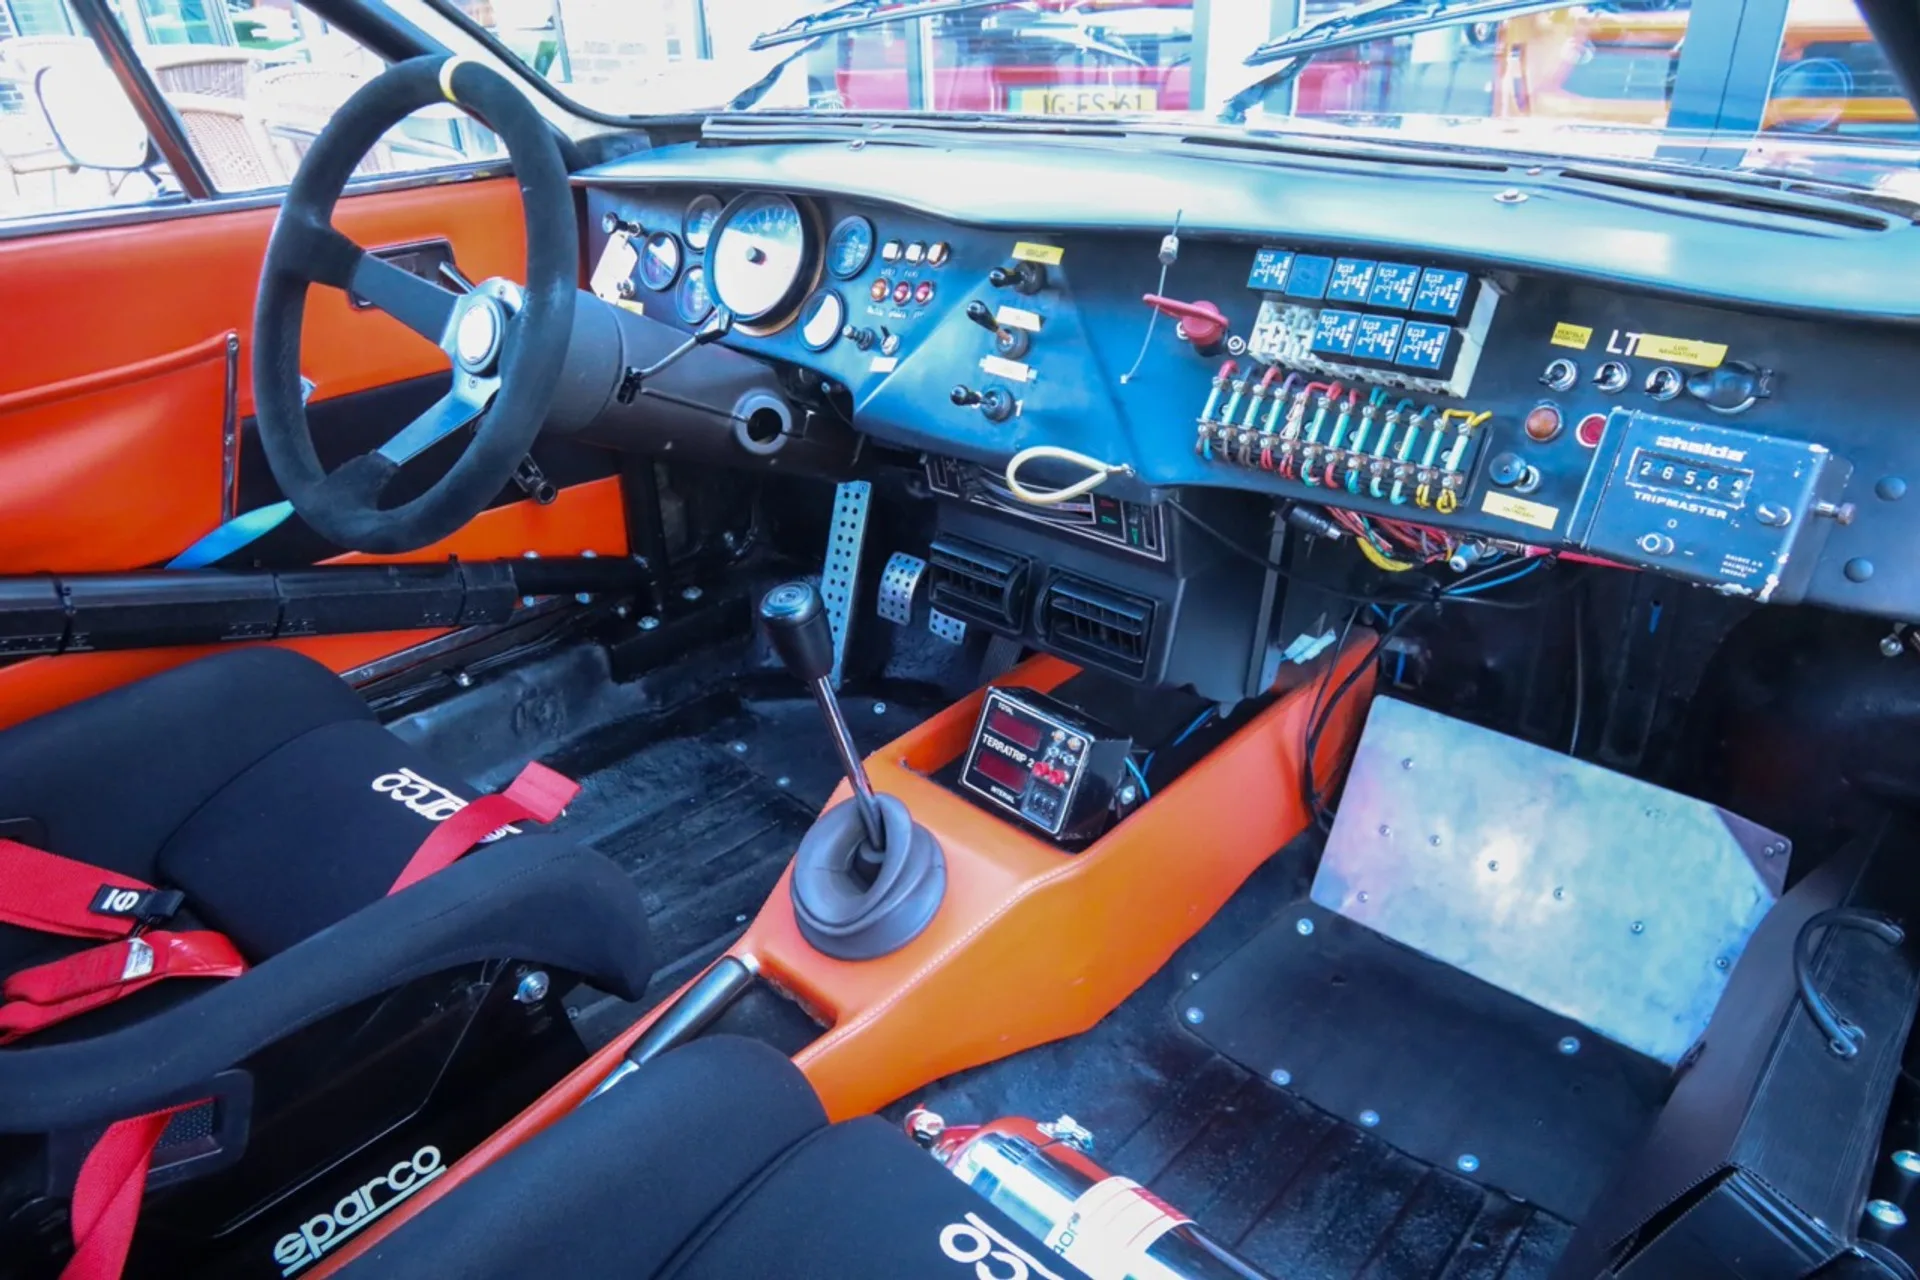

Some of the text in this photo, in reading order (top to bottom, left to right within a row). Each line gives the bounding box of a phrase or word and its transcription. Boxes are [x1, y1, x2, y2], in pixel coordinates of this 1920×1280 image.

[1634, 490, 1728, 519] TRIPMASTER
[982, 733, 1028, 763] TERRATRIP
[273, 1145, 447, 1277] sparco
